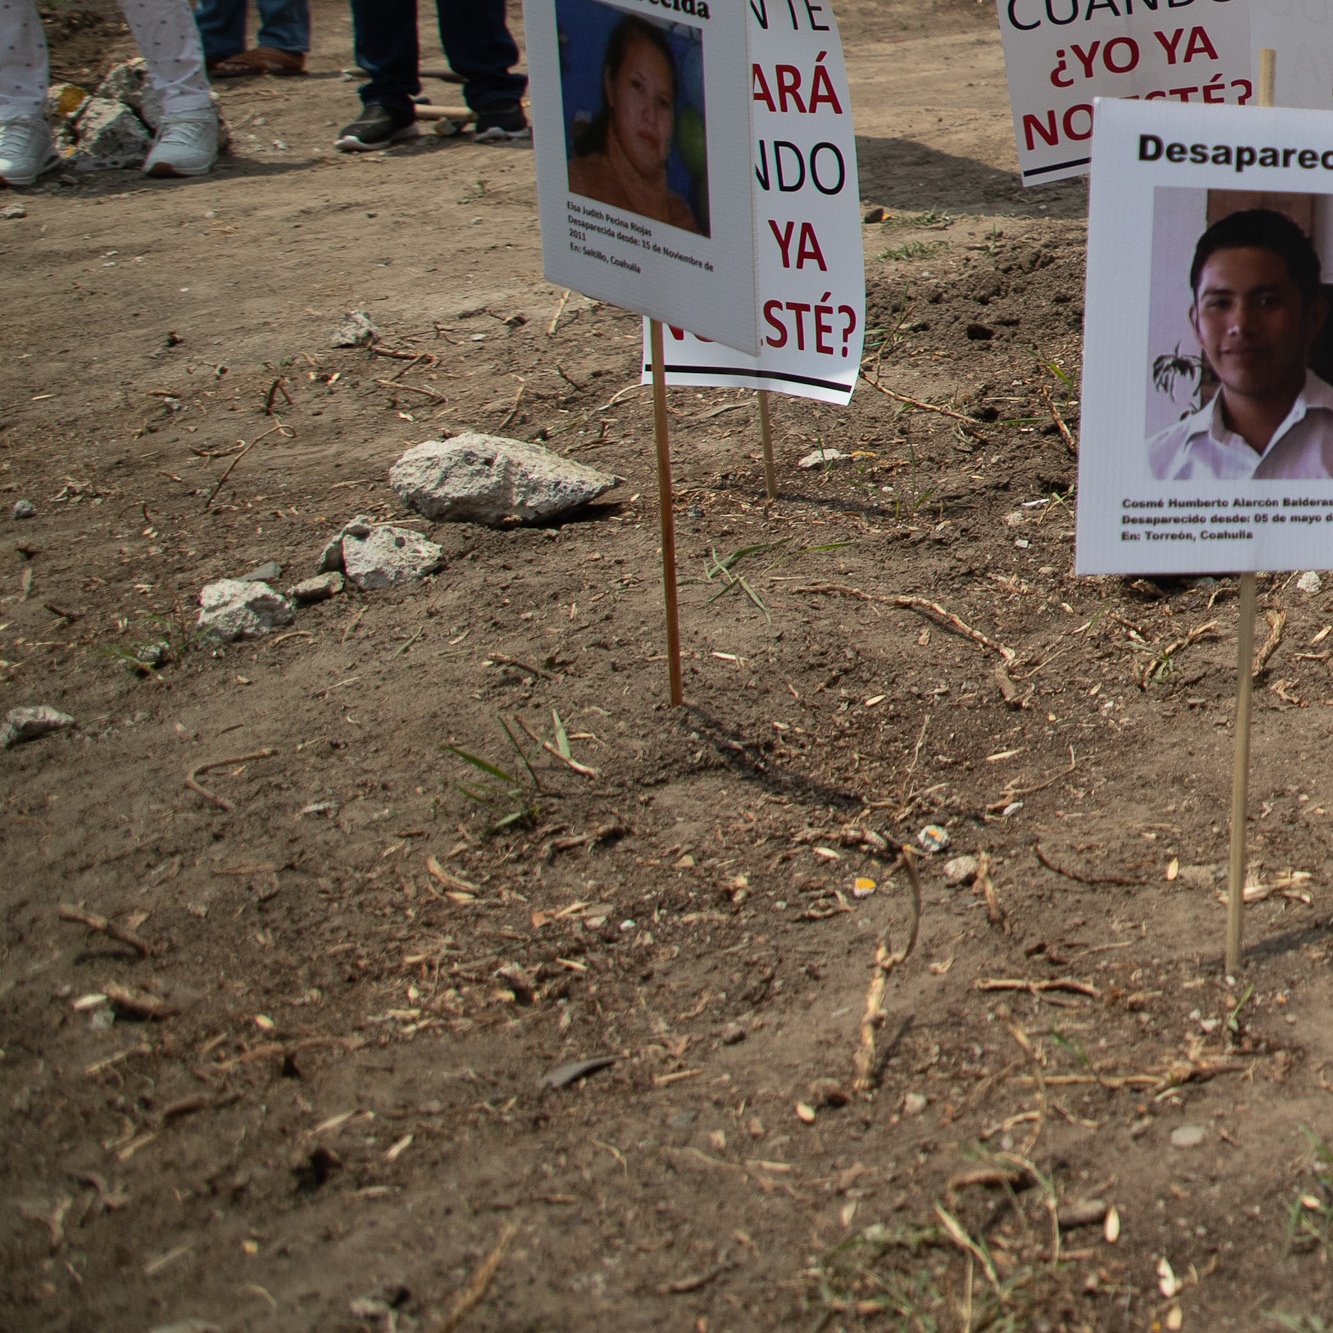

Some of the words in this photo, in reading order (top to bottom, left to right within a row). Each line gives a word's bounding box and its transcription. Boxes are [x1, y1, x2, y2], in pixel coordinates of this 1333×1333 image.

[1049, 35, 1140, 88] ¿YO
[1153, 25, 1219, 65] YA
[1021, 101, 1093, 151] NO
[567, 201, 580, 212] Elsa
[583, 206, 604, 221] Judith
[606, 214, 629, 228] Pecina
[630, 222, 652, 237] Riojas
[568, 215, 615, 238] Desaparecida
[617, 232, 640, 246] desde:
[642, 240, 650, 250] 15
[652, 244, 661, 254] de
[663, 247, 703, 268] Noviembre
[704, 261, 714, 272] de
[570, 228, 586, 241] 2011
[769, 219, 828, 272] YA
[610, 256, 641, 274] Coahuila
[1122, 498, 1165, 508] Cosmé
[1168, 498, 1229, 508] Humberto
[1233, 497, 1279, 507] Alarcón
[1122, 514, 1206, 526] Desaparecido
[1210, 514, 1250, 523] desde:
[1254, 514, 1268, 523] 05
[1272, 514, 1286, 522] de
[1290, 514, 1322, 524] mayo
[1122, 531, 1141, 541] En:
[1145, 530, 1196, 542] Torreón,
